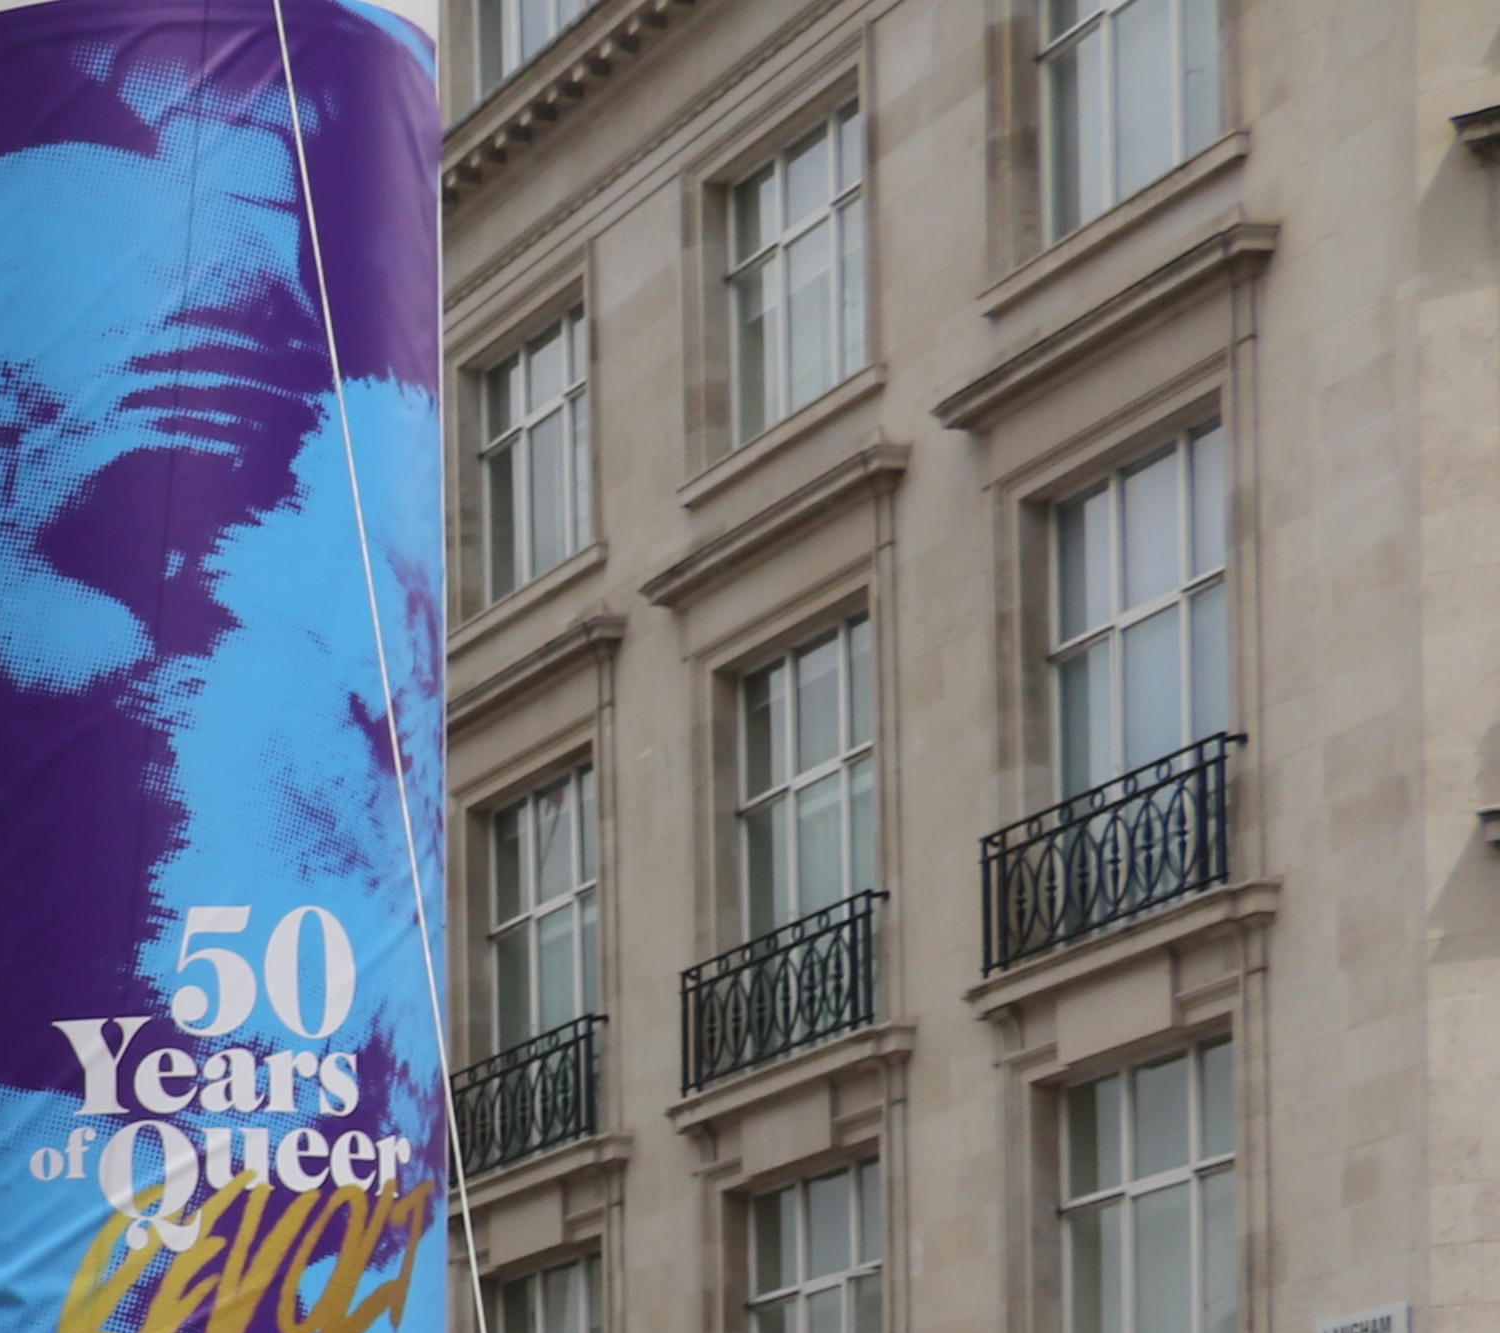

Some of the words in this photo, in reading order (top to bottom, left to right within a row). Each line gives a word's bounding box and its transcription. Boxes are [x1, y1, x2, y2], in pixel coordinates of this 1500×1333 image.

[170, 905, 357, 1040] 50
[51, 1015, 359, 1117] Years
[28, 1127, 97, 1181] of
[99, 1119, 412, 1253] Queer
